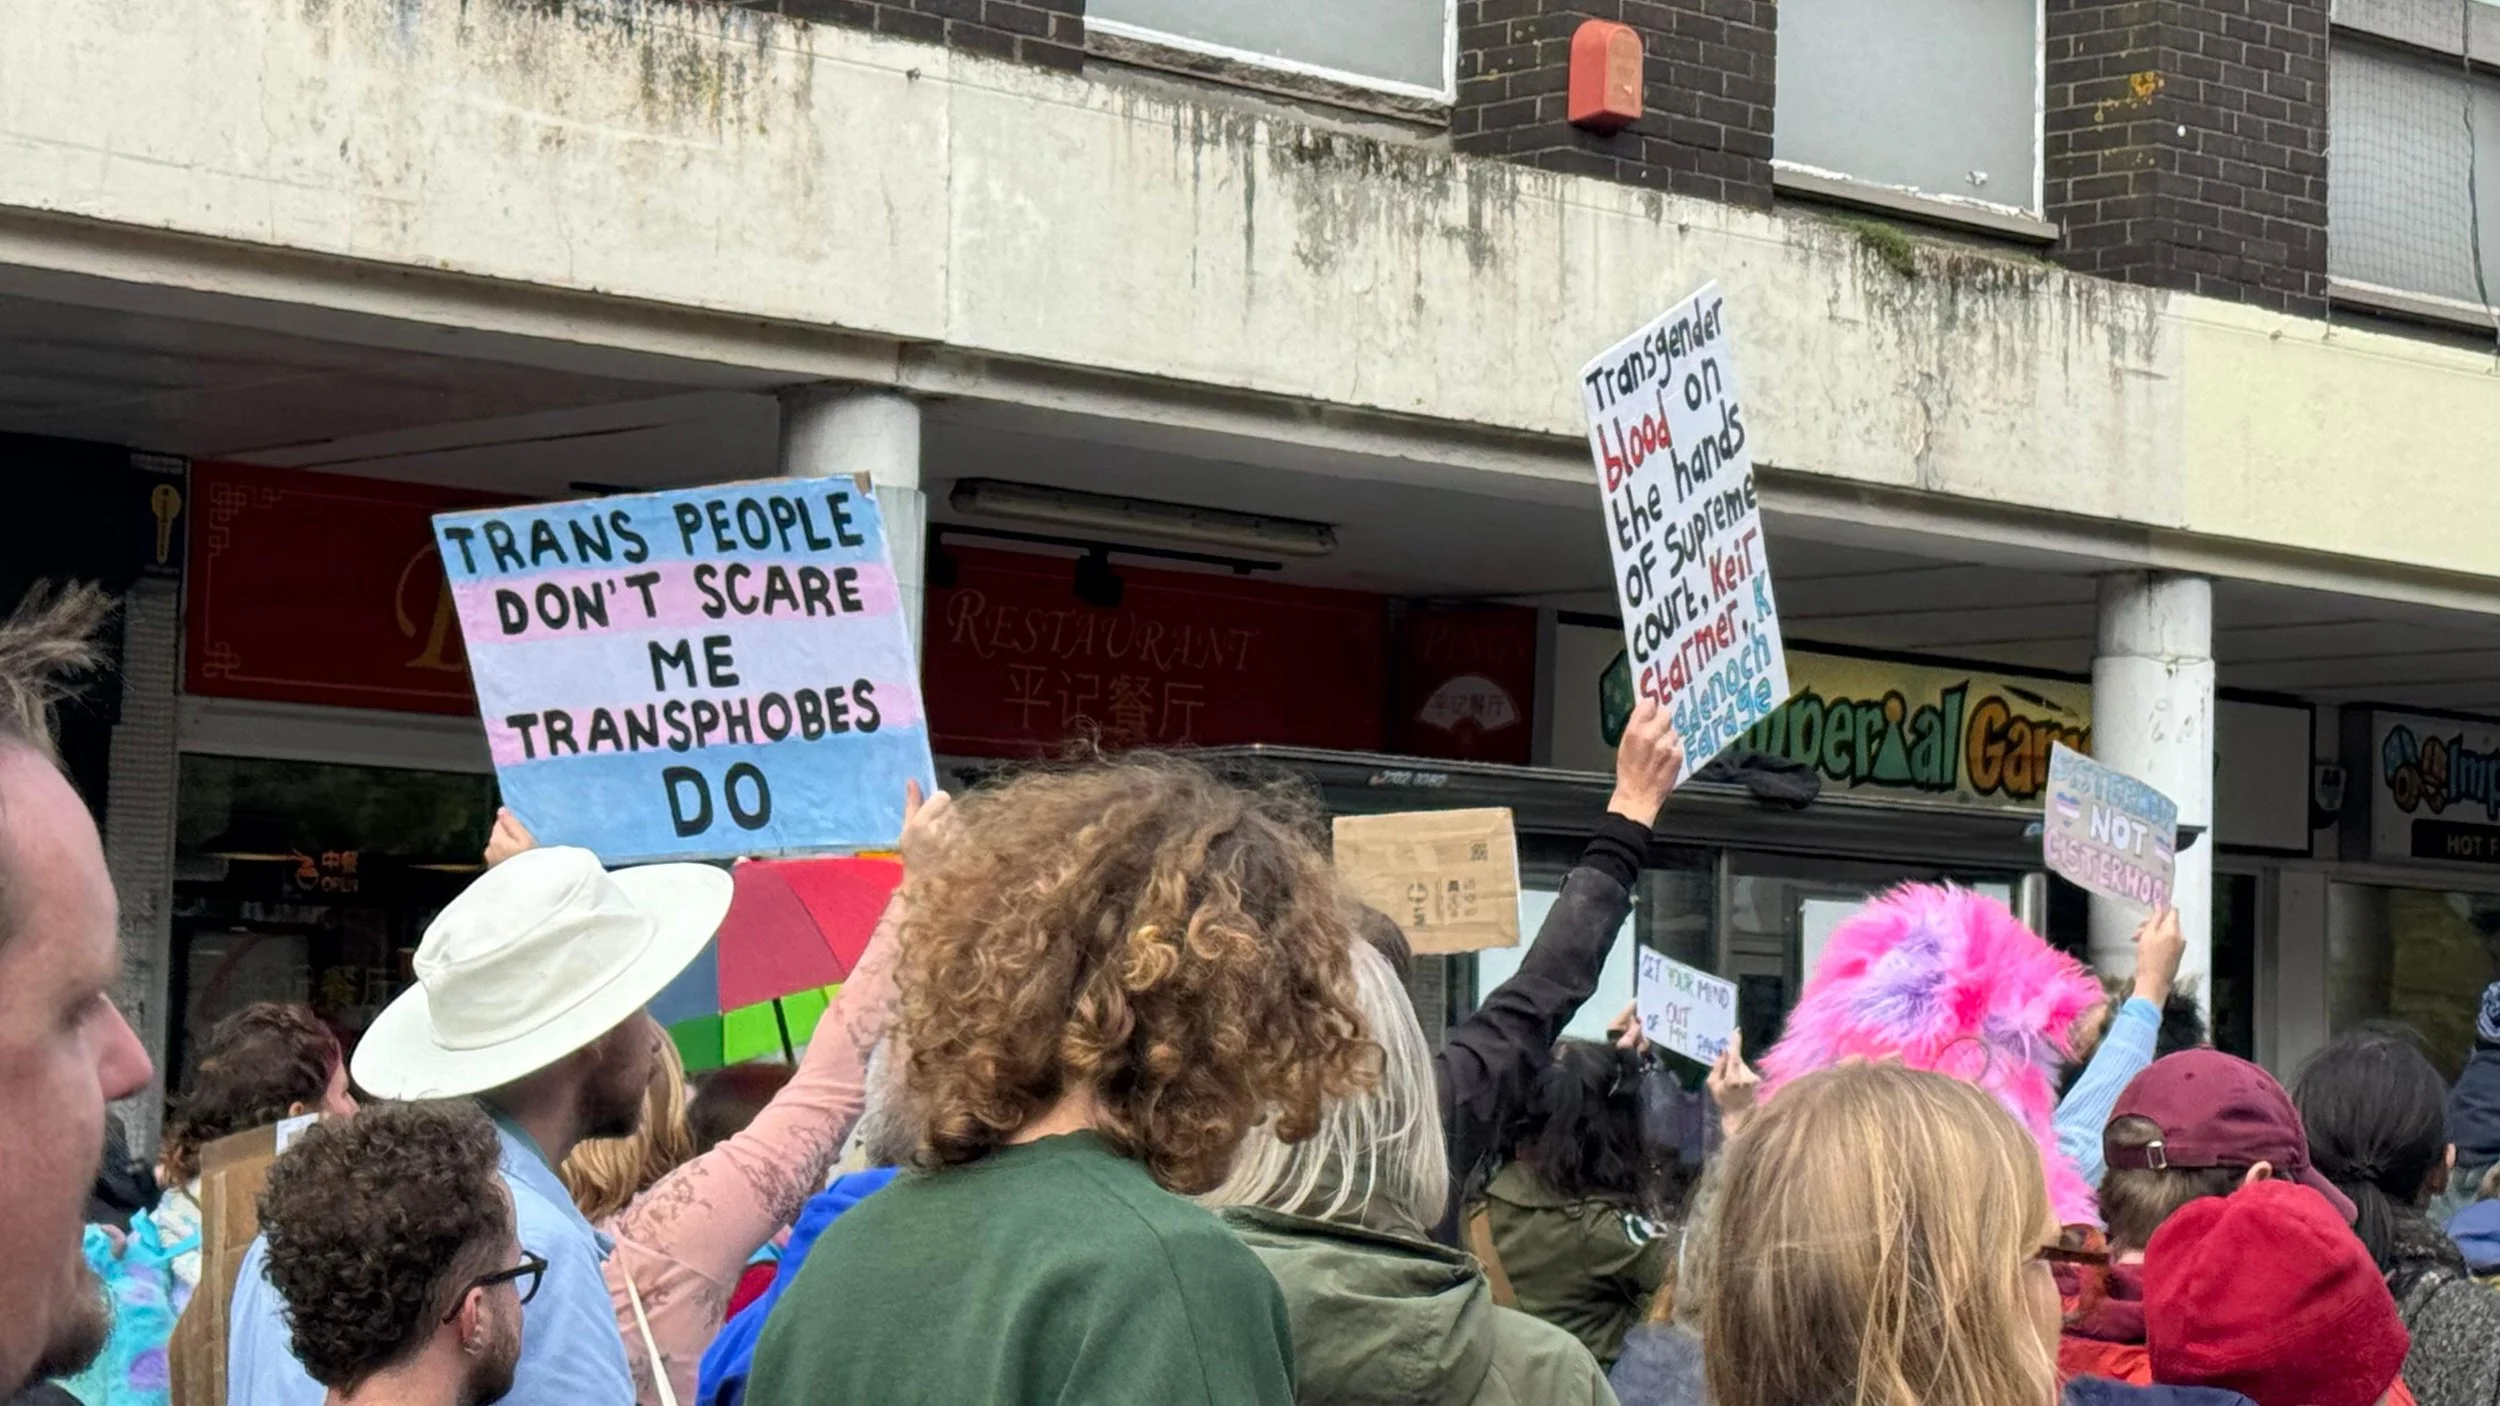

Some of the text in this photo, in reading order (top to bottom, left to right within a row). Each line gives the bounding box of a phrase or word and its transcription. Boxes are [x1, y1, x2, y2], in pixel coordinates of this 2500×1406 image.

[1586, 297, 1723, 412] Transgender
[1597, 357, 1722, 493] blood on
[1611, 399, 1745, 552] the hands
[445, 491, 864, 575] TRANS PEOPLE
[1664, 474, 1758, 579] Supreme
[495, 572, 660, 636] DON'T
[695, 562, 864, 620] SCARE
[1633, 527, 1757, 663] court, Keir
[1752, 569, 1773, 623] K
[648, 634, 740, 692] ME
[1002, 663, 1205, 741] 平记餐厅
[1671, 622, 1772, 738] adenoch
[506, 678, 881, 759] TRANSPHOBES
[1684, 677, 1772, 773] Farage
[662, 761, 771, 838] DO
[2090, 803, 2148, 858] NOT
[2447, 834, 2483, 857] HOT
